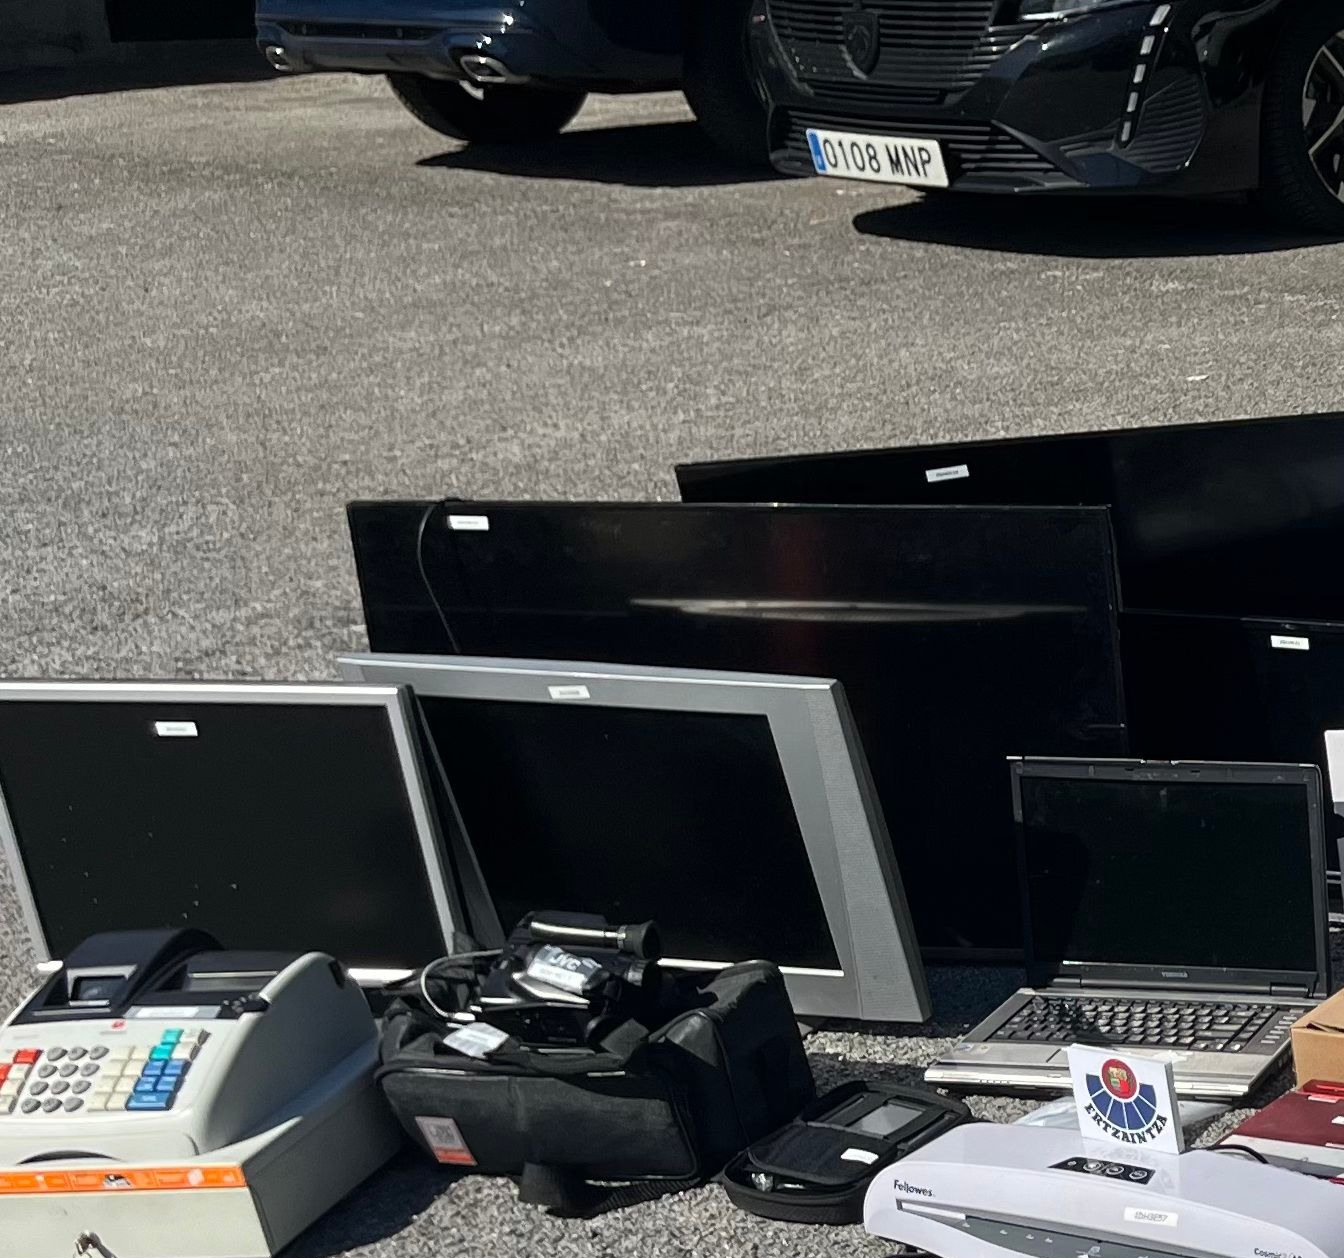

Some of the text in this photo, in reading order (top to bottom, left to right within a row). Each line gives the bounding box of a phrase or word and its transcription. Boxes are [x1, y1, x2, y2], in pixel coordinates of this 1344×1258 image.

[822, 138, 932, 178] 0108 MNP
[1084, 1102, 1168, 1144] ERTZAINTZA
